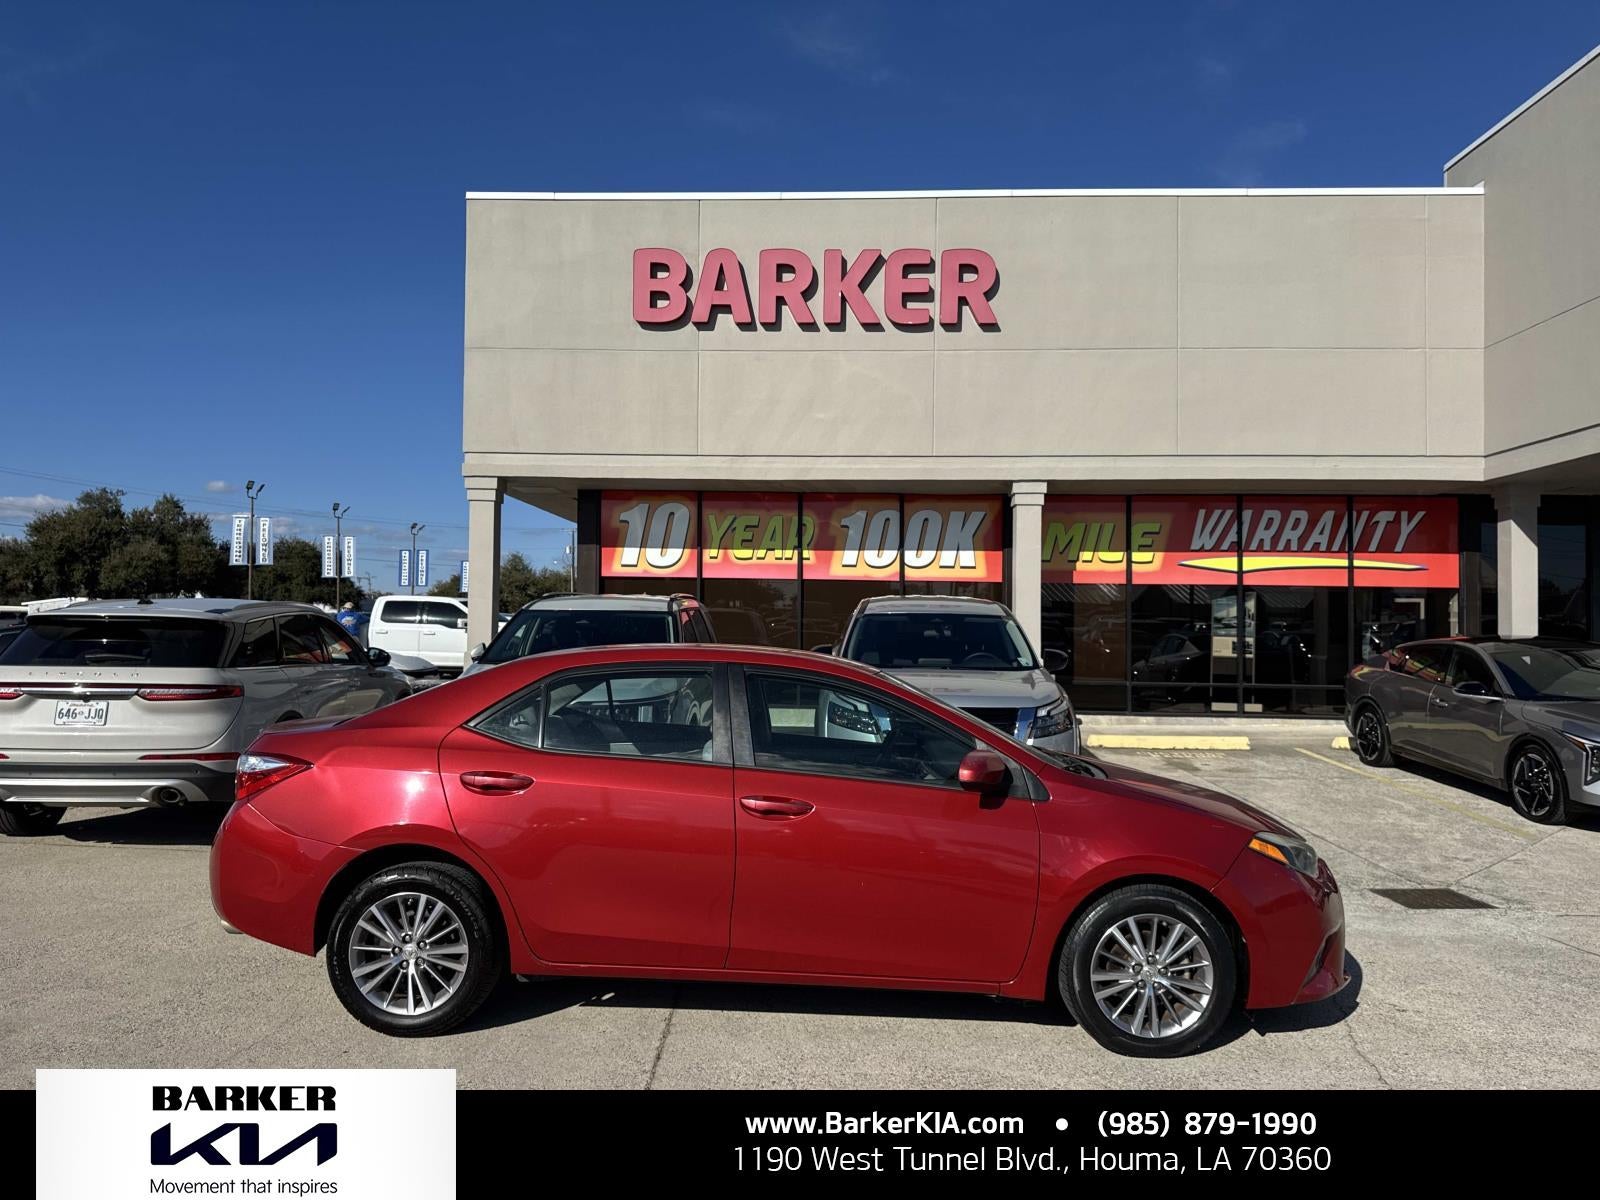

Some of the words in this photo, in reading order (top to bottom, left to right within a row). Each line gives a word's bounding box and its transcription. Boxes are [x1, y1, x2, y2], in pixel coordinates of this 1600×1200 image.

[633, 247, 1000, 328] BARKER
[619, 502, 691, 569] 10
[707, 514, 816, 561] YEAR
[840, 509, 987, 569] 100K
[1041, 521, 1161, 564] MILE
[1190, 508, 1427, 554] WARRANTY
